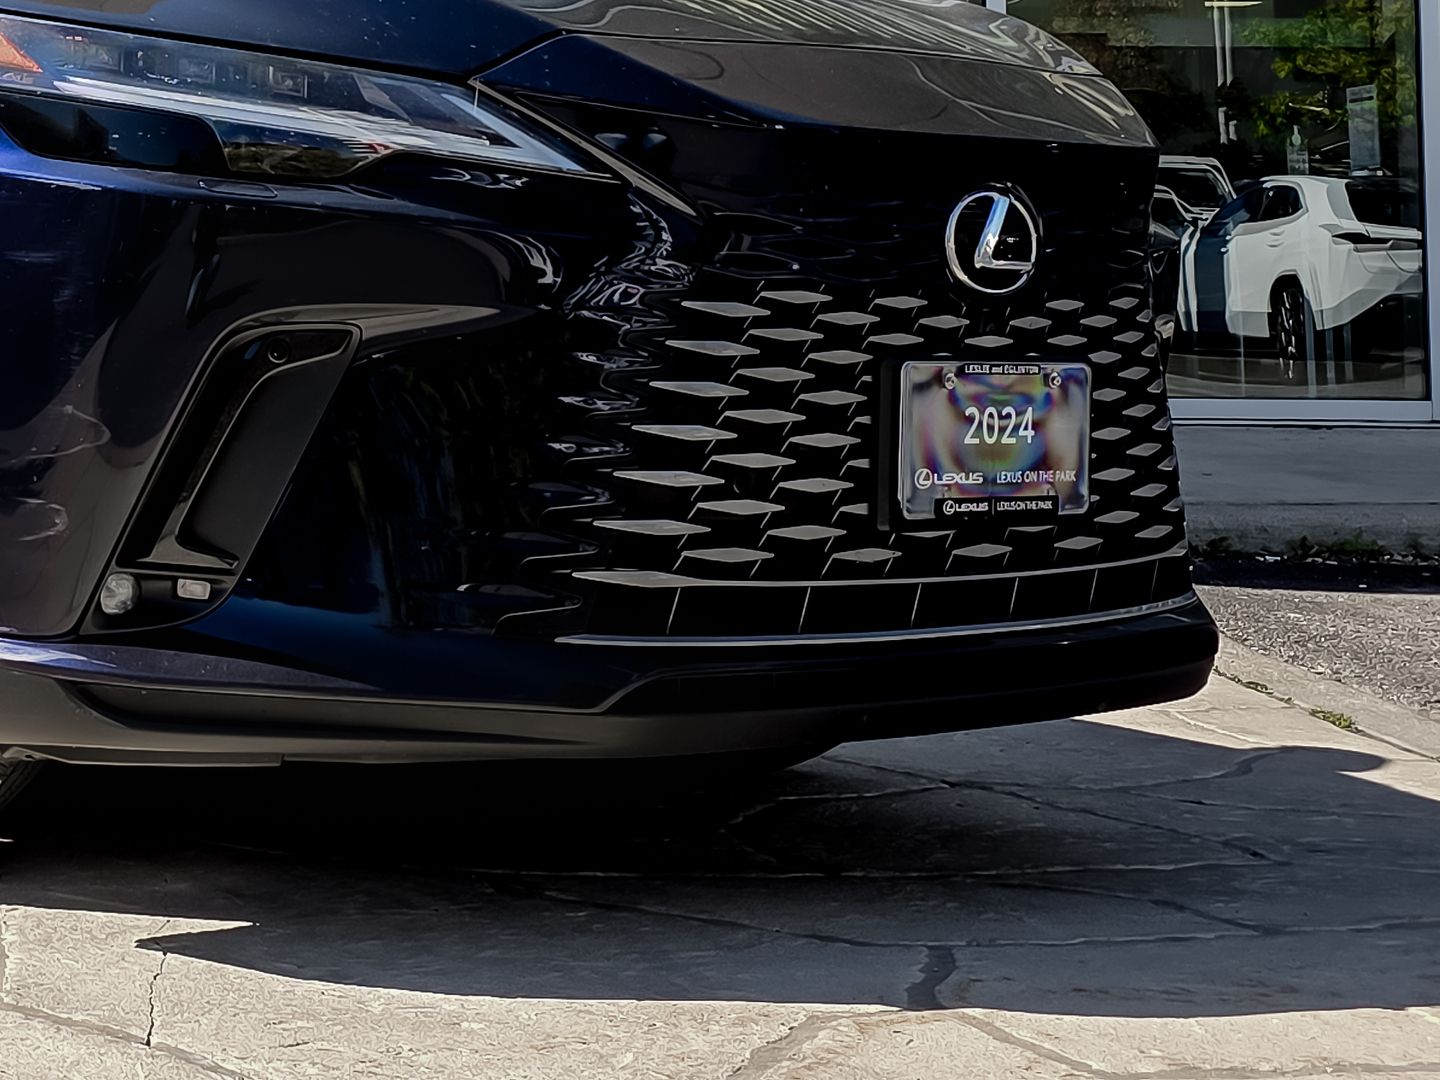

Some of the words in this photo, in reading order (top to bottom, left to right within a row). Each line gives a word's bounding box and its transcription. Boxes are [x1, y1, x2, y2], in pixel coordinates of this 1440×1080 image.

[963, 406, 1035, 444] 2024
[933, 471, 984, 484] LEXUS
[996, 470, 1023, 484] LEXUS
[1023, 471, 1038, 483] ON
[1038, 470, 1054, 483] THE
[1055, 470, 1077, 482] PARK
[955, 502, 989, 512] LEXUS
